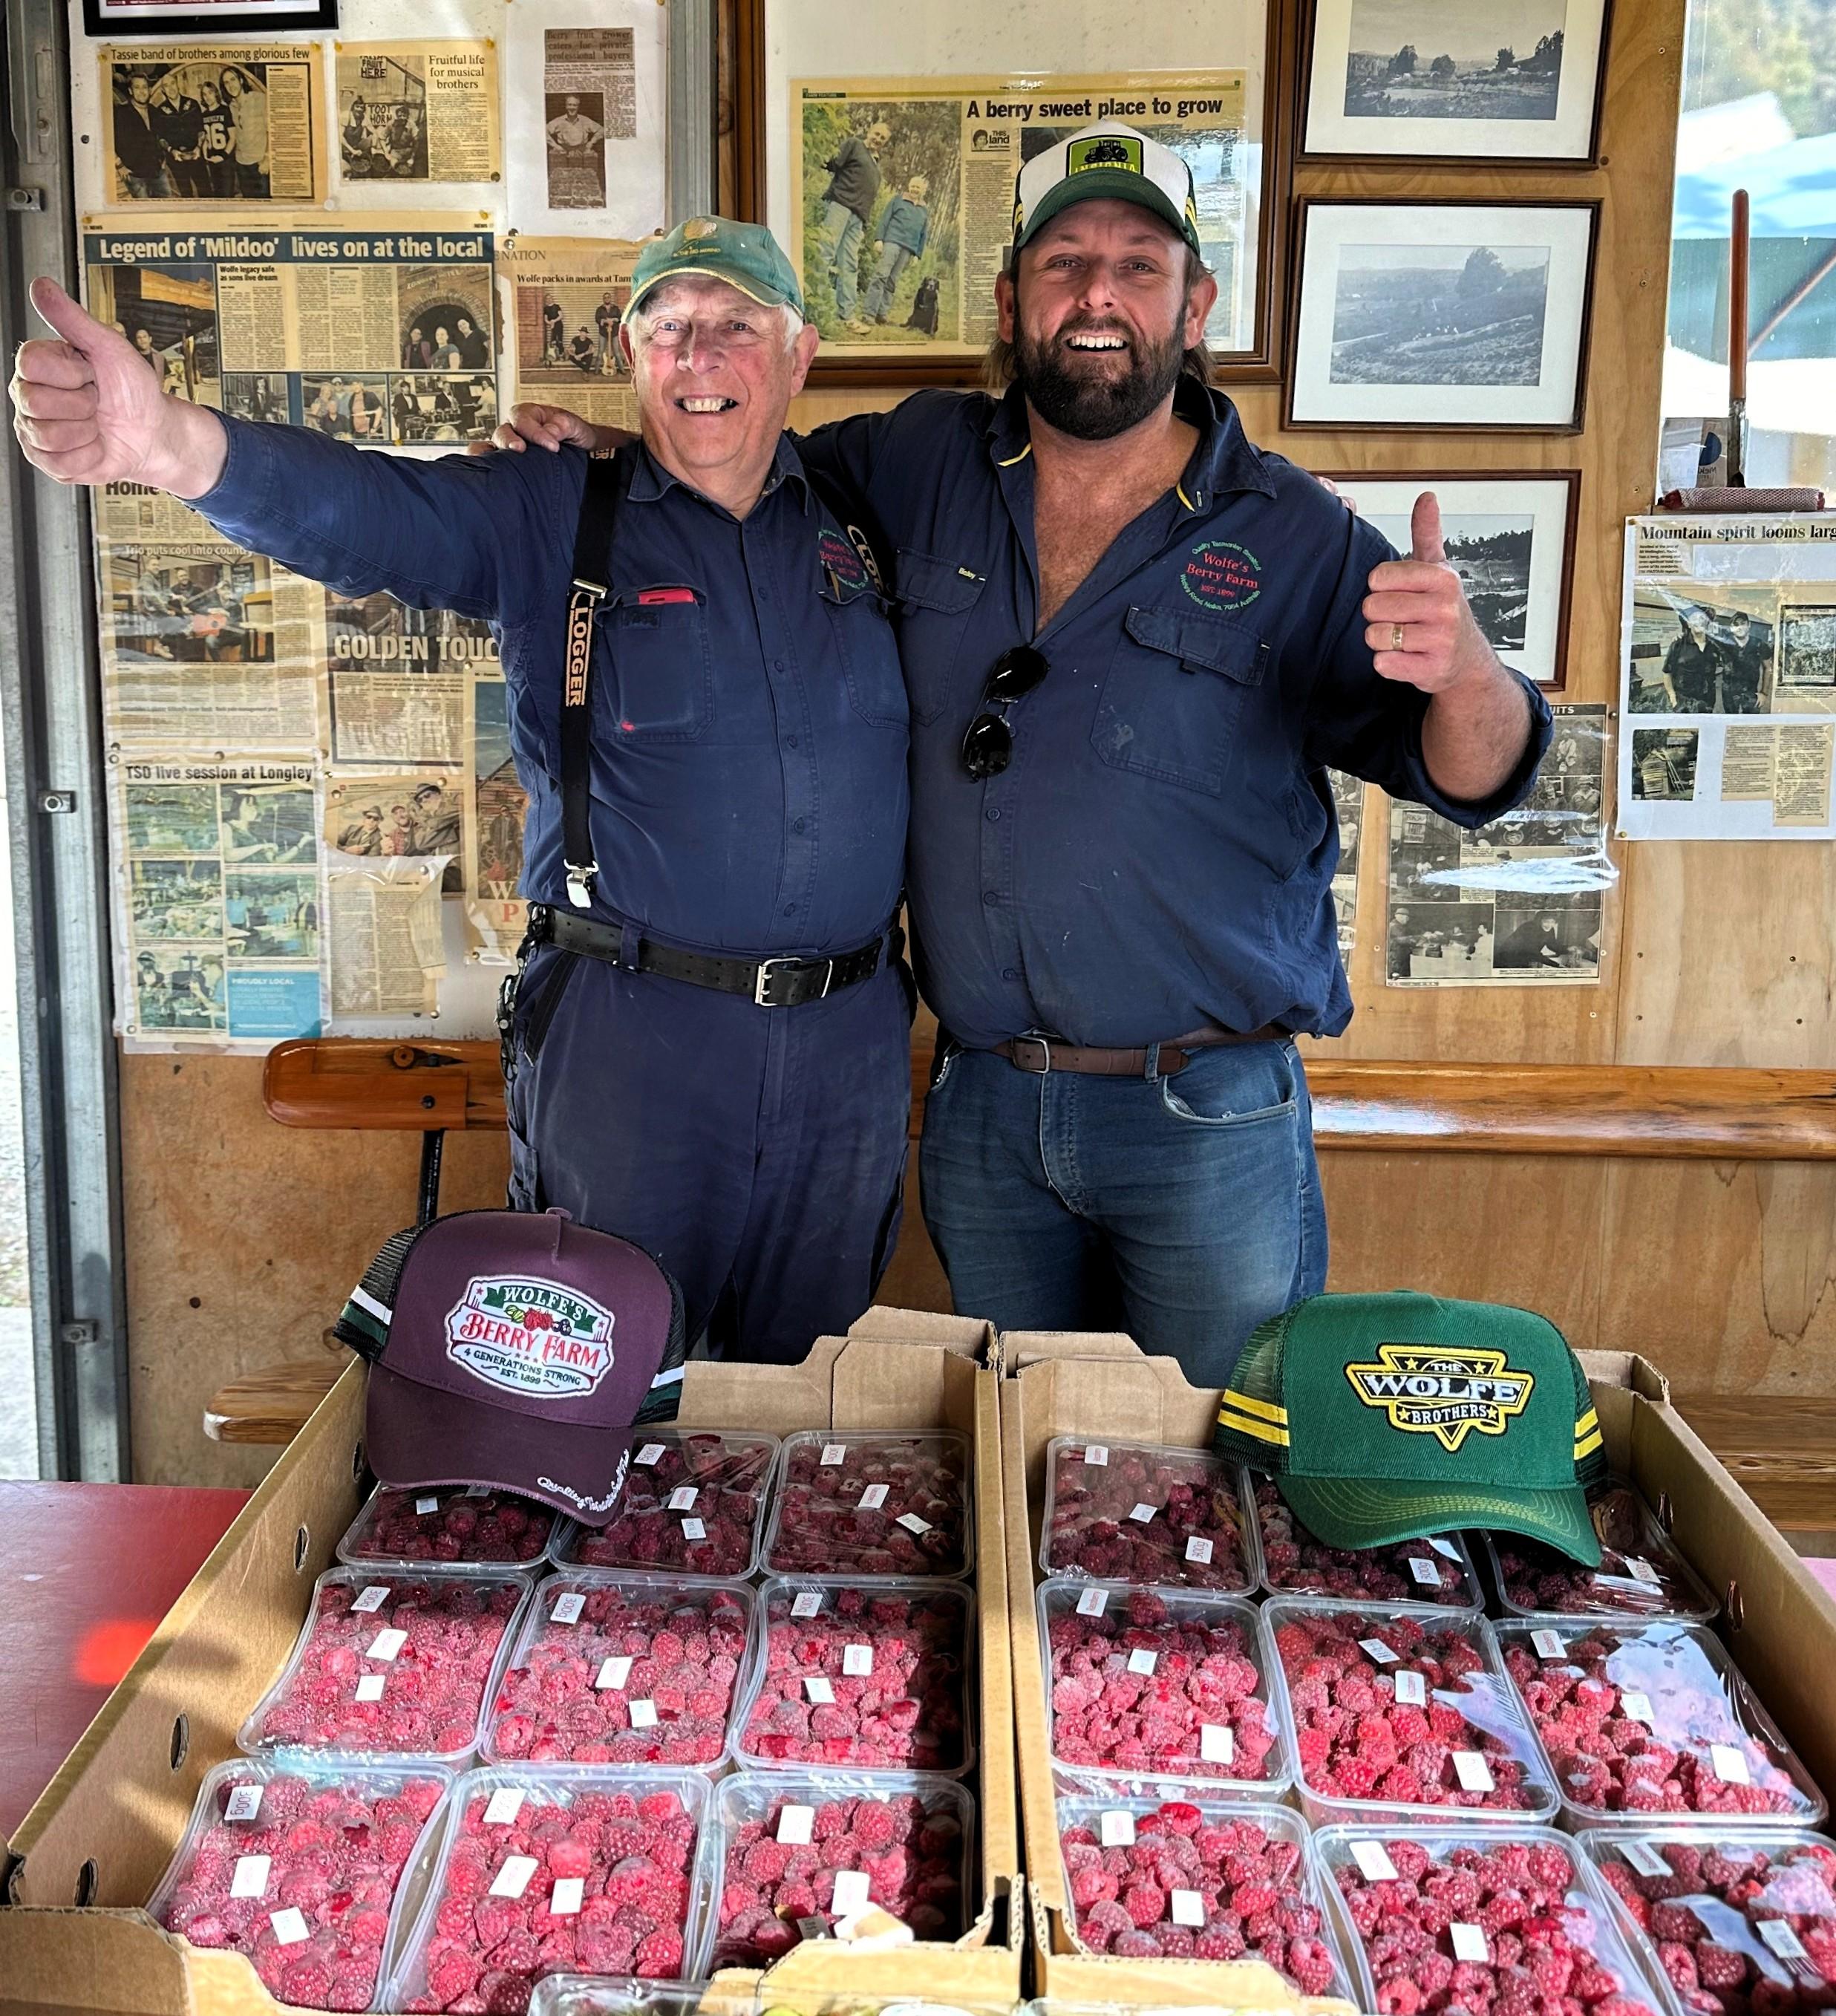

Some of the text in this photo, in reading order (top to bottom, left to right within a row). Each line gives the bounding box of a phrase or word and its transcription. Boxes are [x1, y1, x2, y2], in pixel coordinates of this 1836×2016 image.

[111, 48, 310, 61] Tassie band of brothers among glorious few
[429, 55, 485, 65] Fruitful life
[361, 68, 386, 79] HERE
[430, 67, 484, 76] for musical
[437, 79, 479, 89] brothers
[967, 97, 1223, 121] A berry sweet place to grow
[989, 134, 1010, 144] land
[99, 237, 171, 262] Legend
[174, 237, 196, 257] of
[291, 236, 339, 257] lives
[343, 241, 369, 257] on
[373, 238, 394, 257] at
[398, 236, 432, 257] the
[436, 236, 483, 257] local
[501, 250, 546, 260] NATION
[240, 266, 260, 274] legacy
[517, 274, 541, 282] Wolfe
[542, 274, 564, 283] packs
[575, 275, 603, 283] awards
[1640, 526, 1712, 540] Mountain
[1716, 525, 1756, 541] spirit
[1762, 525, 1806, 538] looms
[125, 545, 144, 555] Trio
[147, 545, 167, 557] puts
[171, 545, 191, 555] cool
[193, 545, 212, 555] into
[1203, 552, 1249, 572] Wolfe's
[1186, 563, 1258, 589] Berry Farm
[334, 634, 428, 660] GOLDEN
[125, 766, 312, 782] TSO live session at Longley
[503, 1287, 584, 1321] WOLFE'S
[460, 1313, 601, 1369] BERRY FARM
[463, 1348, 582, 1386] 4 GENERATIONS STRONG
[1430, 1363, 1463, 1372] THE
[500, 1368, 541, 1385] EST. 1899
[1363, 1374, 1523, 1403] WOLFE
[1412, 1403, 1488, 1424] BROTHERS
[638, 1446, 659, 1462] 300g
[537, 1476, 586, 1510] Quality
[1417, 1562, 1434, 1580] 300g
[358, 1590, 382, 1608] 300g
[555, 1597, 578, 1619] 300g
[795, 1595, 815, 1613] 300g
[230, 1791, 254, 1816] 300g
